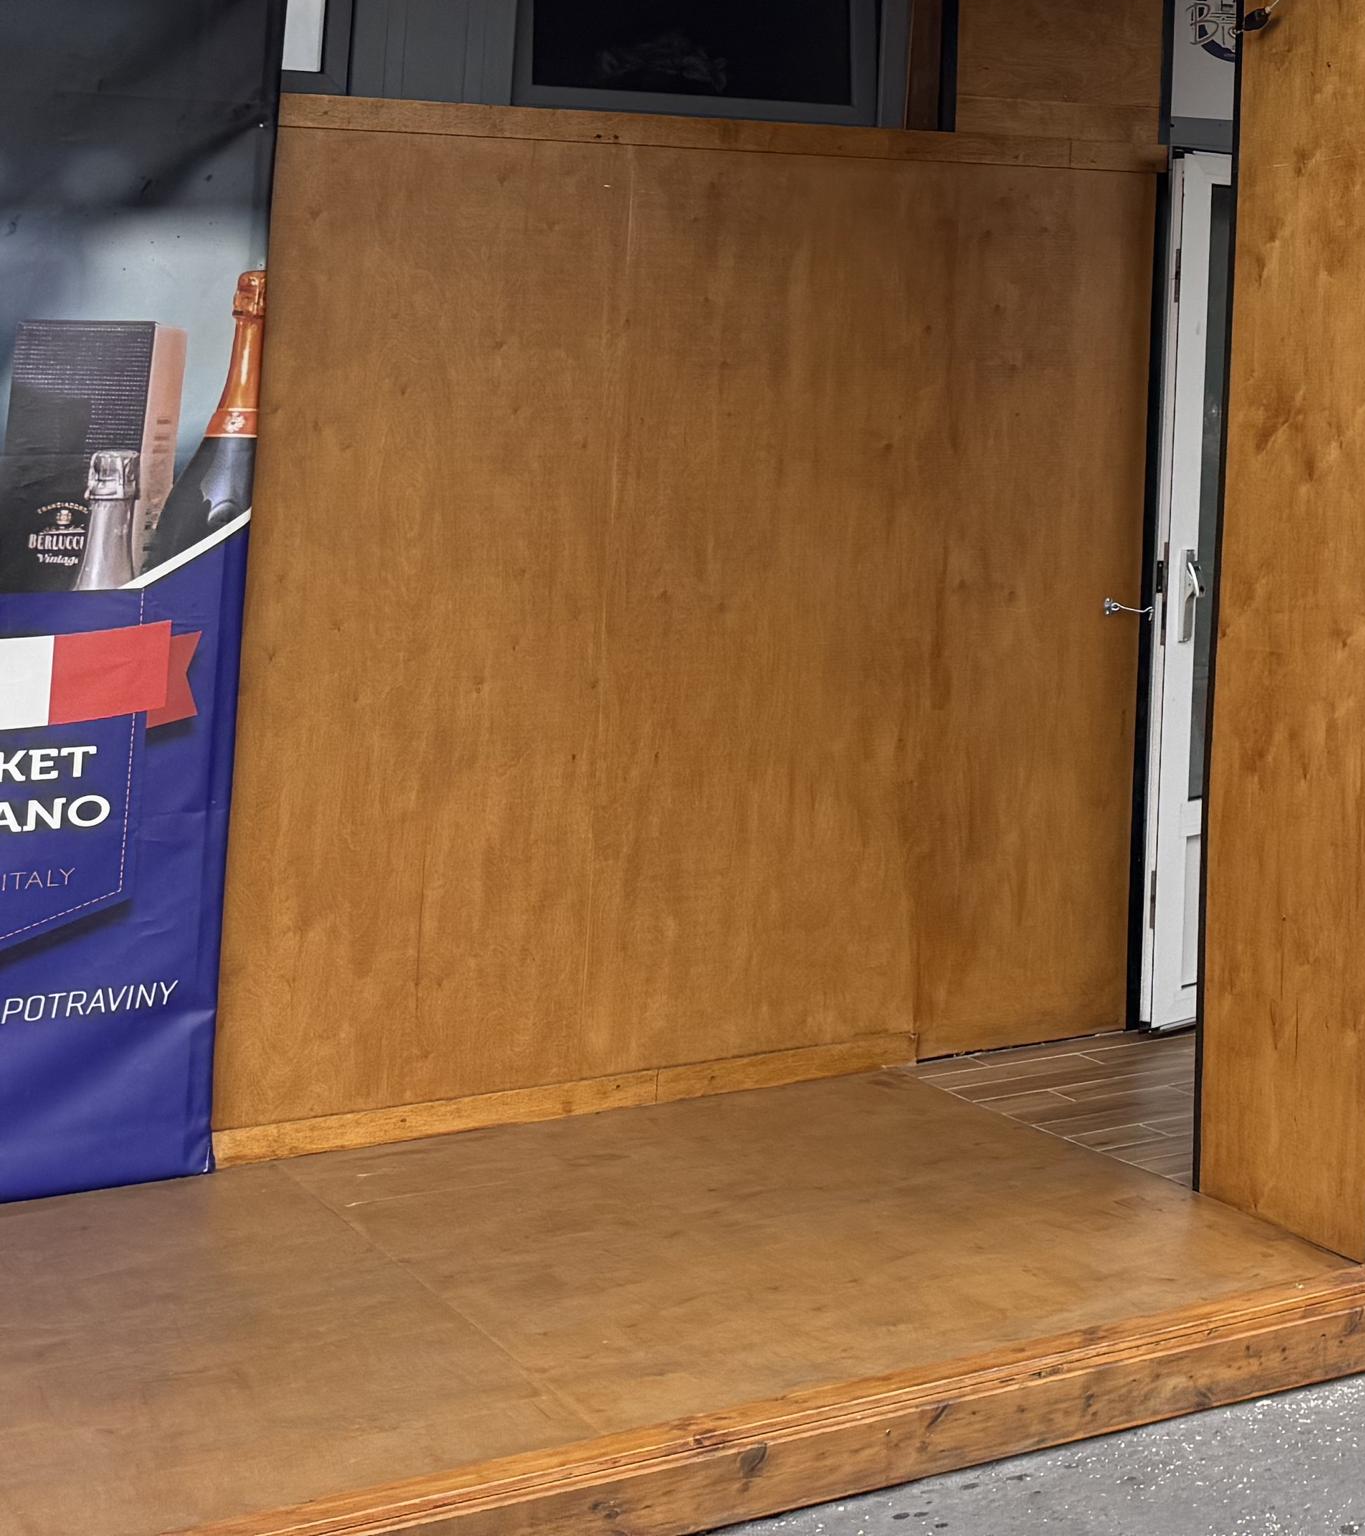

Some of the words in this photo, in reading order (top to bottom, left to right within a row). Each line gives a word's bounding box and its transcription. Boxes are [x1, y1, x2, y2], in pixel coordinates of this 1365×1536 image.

[28, 533, 85, 550] BERLUCCI
[2, 867, 75, 891] ITALY
[1, 979, 178, 1024] POTRAVINY
